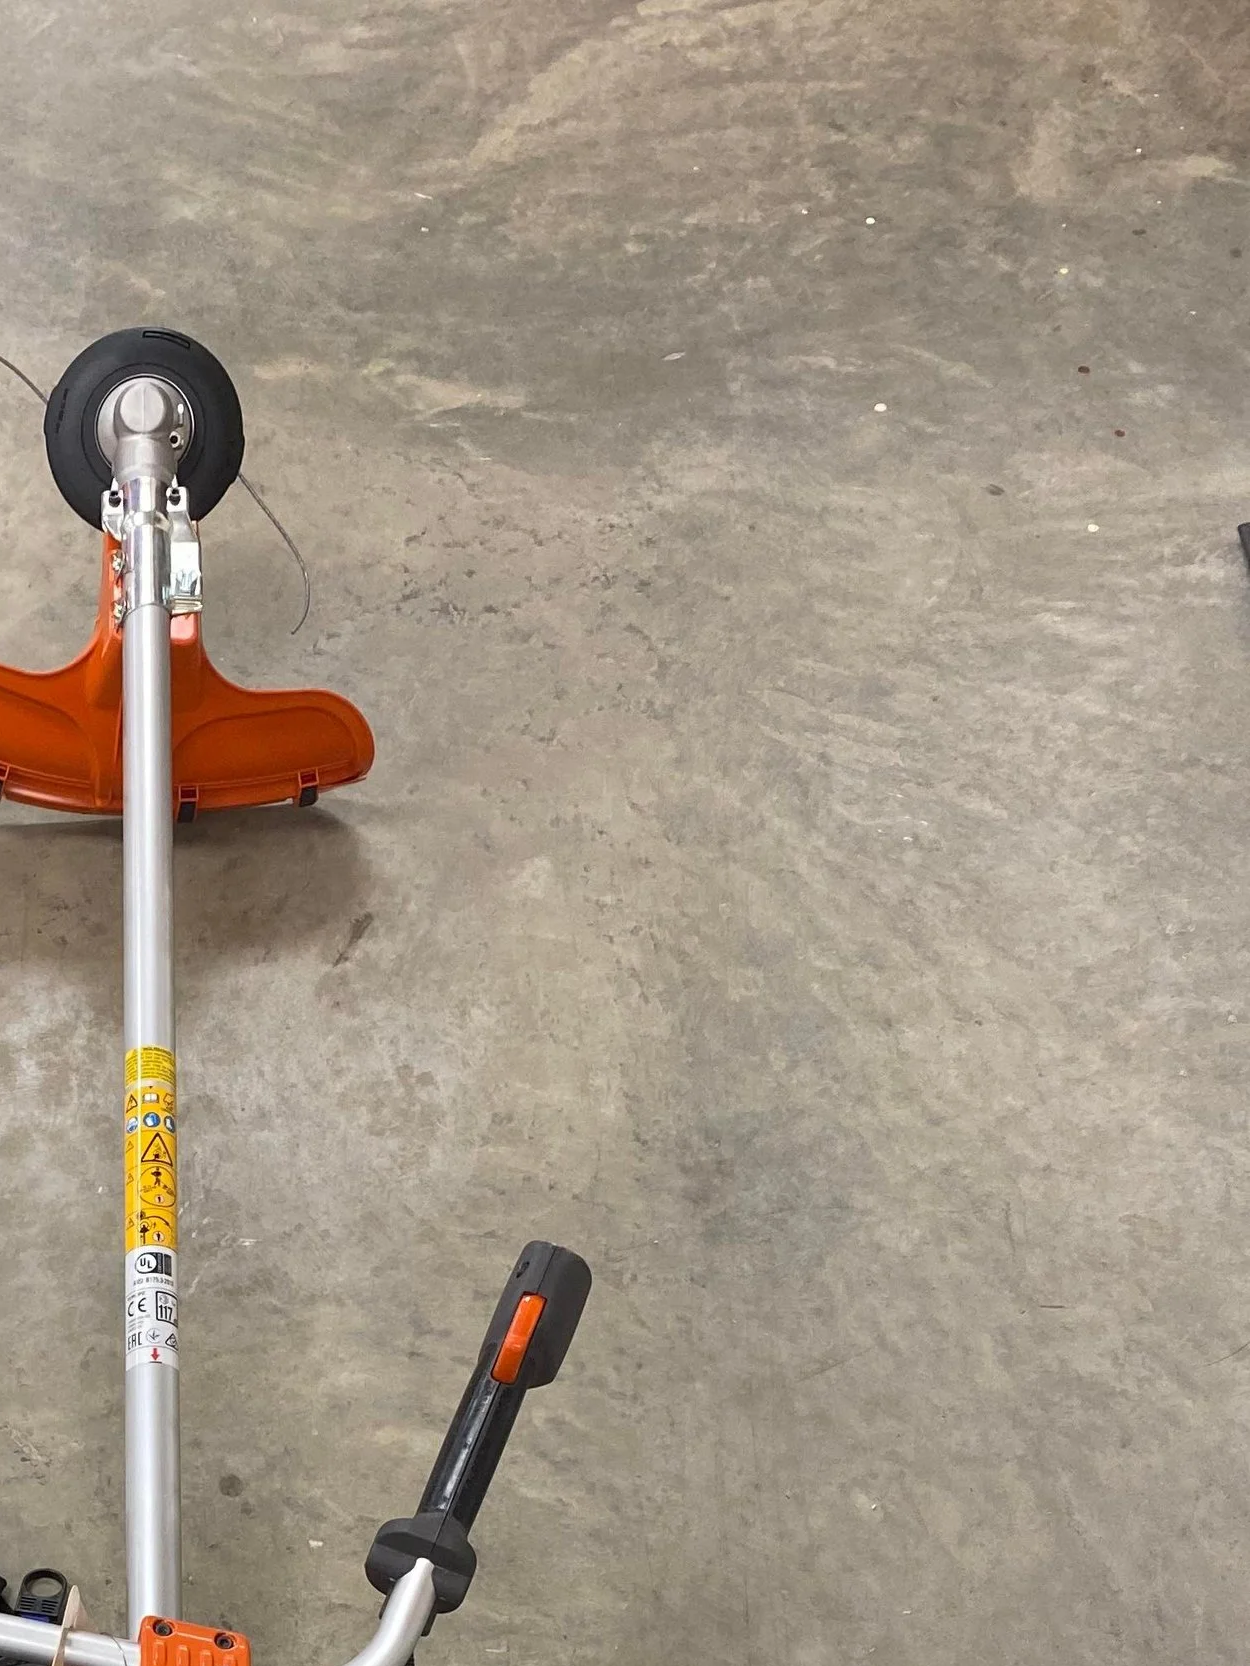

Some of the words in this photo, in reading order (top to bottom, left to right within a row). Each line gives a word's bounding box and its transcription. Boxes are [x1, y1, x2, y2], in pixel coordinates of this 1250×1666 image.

[140, 1257, 153, 1269] UL
[127, 1297, 147, 1317] CE
[158, 1304, 173, 1321] 117
